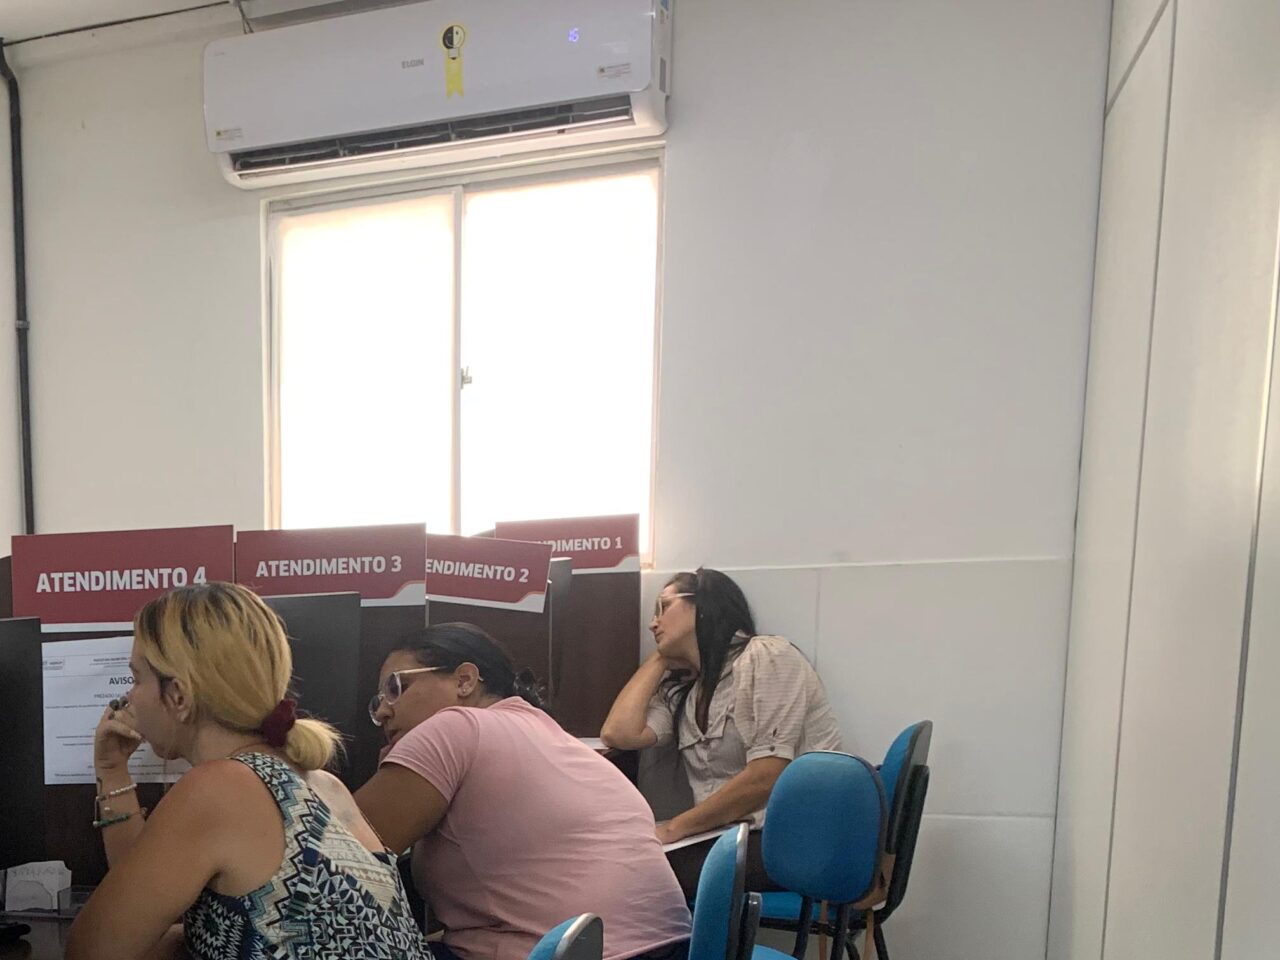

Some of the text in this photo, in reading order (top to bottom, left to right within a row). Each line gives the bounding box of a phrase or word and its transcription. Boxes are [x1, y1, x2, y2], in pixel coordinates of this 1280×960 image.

[401, 58, 425, 69] ELGIN
[541, 536, 622, 552] DIMENTO 1
[255, 555, 402, 577] ATENDIMENTO 3
[425, 558, 529, 583] ENDIMENTO 2
[36, 566, 207, 593] ATENDIMENTO 4
[108, 676, 135, 686] AVISO
